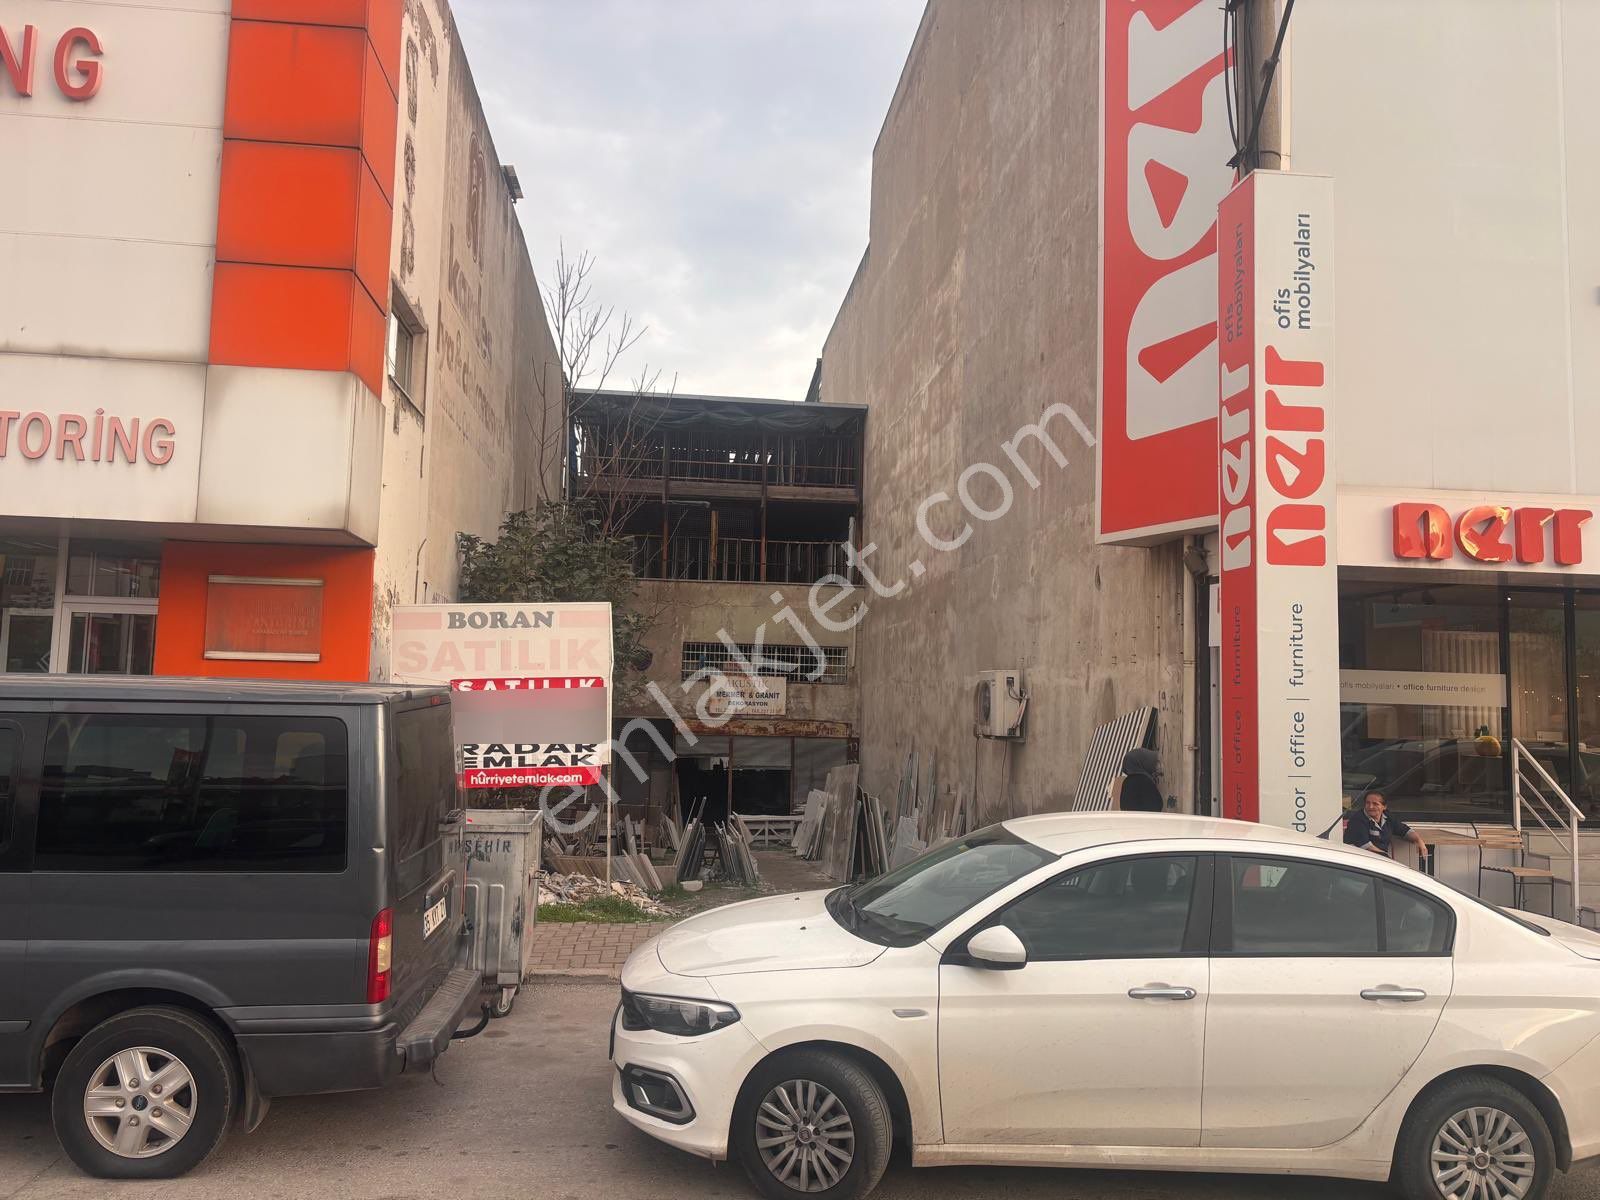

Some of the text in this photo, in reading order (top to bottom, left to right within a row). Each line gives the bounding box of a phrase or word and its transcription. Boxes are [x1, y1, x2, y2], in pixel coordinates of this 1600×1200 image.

[1126, 0, 1236, 441] ner
[1293, 213, 1315, 330] mobilyaları
[1224, 303, 1234, 342] ofis
[1273, 288, 1291, 329] ofis
[447, 610, 554, 630] BORAN
[400, 638, 602, 673] SATILIK
[1403, 683, 1425, 691] office
[1233, 710, 1242, 764] office
[1288, 603, 1307, 833] door office furniture
